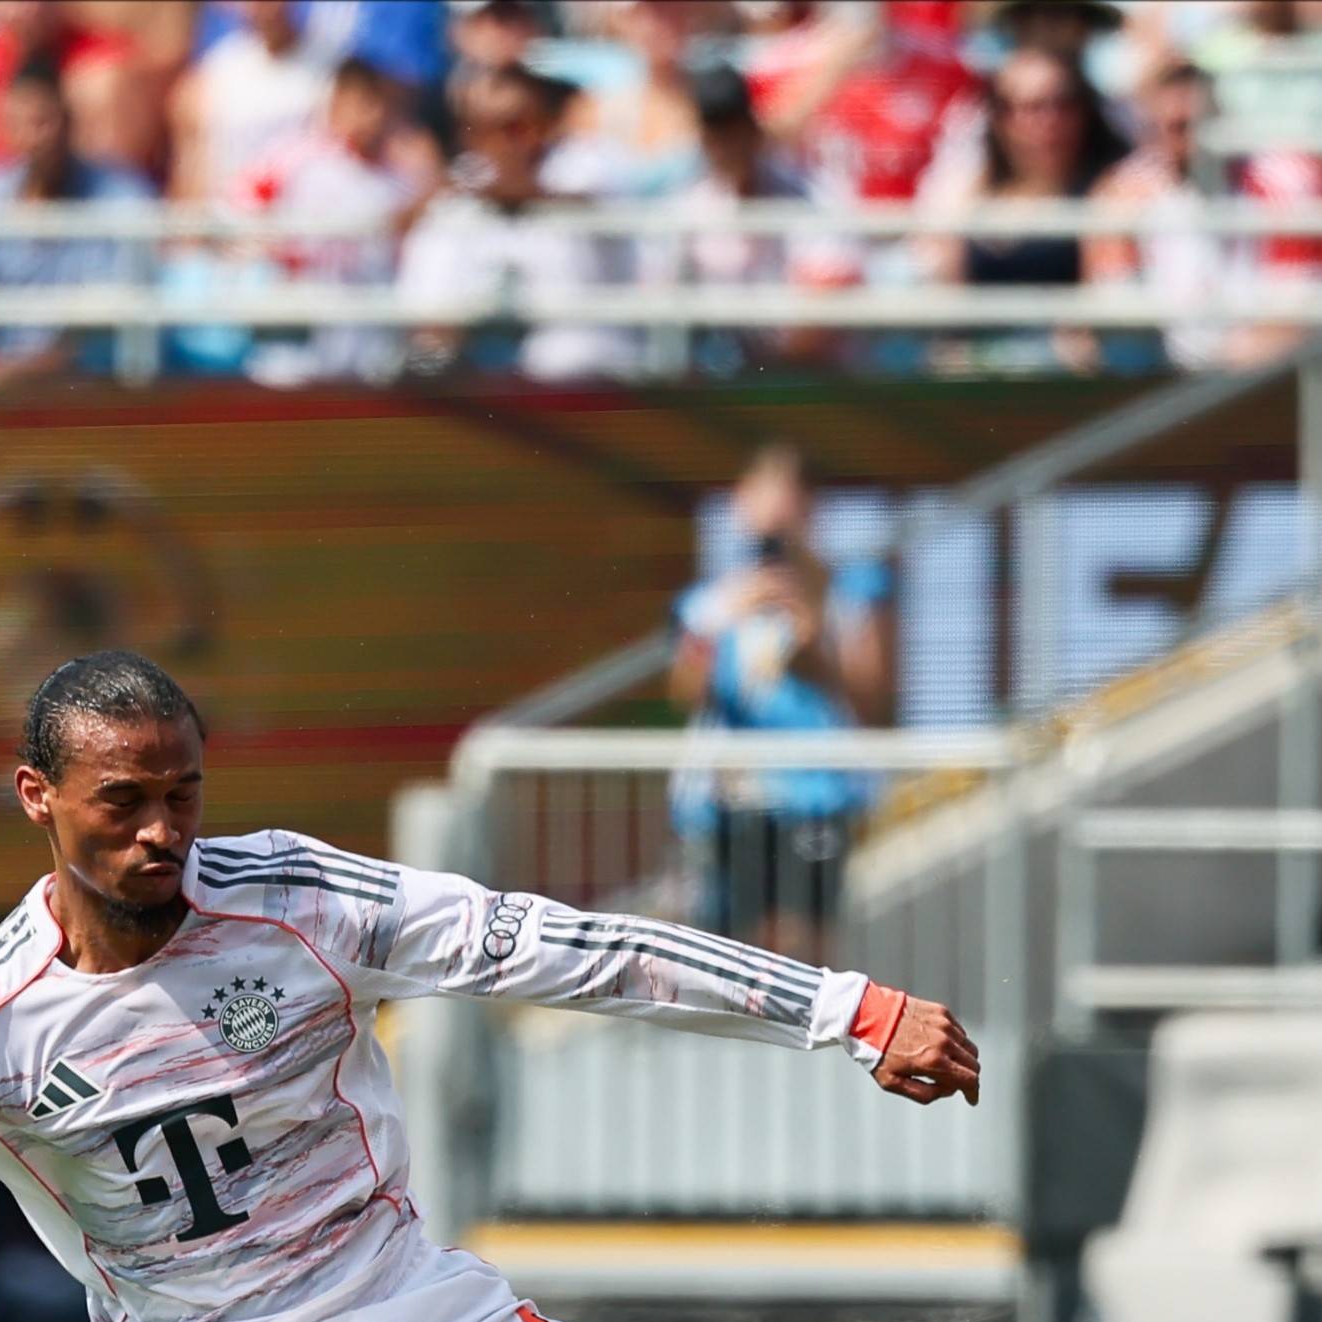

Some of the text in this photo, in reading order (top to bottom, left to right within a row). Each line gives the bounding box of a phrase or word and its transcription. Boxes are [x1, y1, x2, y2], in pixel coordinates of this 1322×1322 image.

[223, 998, 271, 1025] FC BAYERN
[113, 1094, 253, 1242] T
